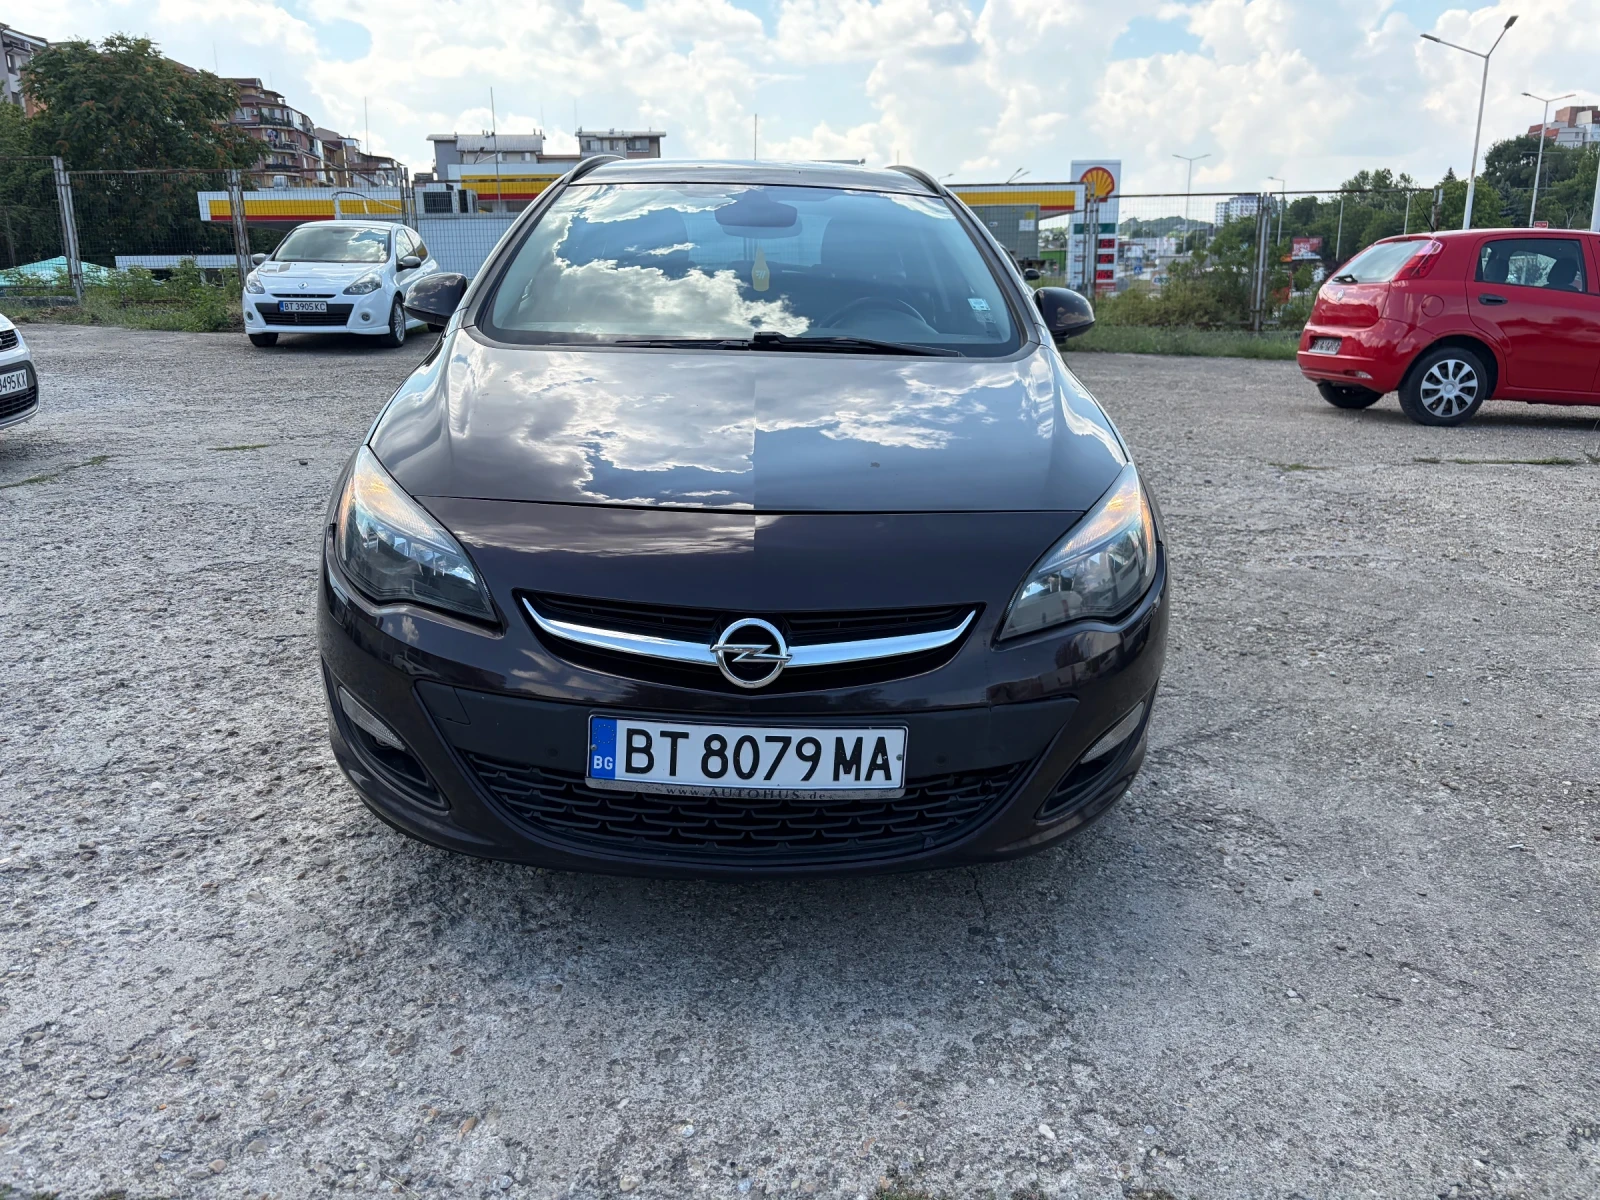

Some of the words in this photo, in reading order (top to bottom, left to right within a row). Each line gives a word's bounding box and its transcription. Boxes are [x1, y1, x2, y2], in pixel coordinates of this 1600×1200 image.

[284, 302, 294, 310] BT
[296, 302, 314, 310] 3905
[315, 302, 326, 311] KC
[625, 727, 690, 777] BT
[701, 733, 822, 782] 8079
[832, 736, 892, 782] MA
[593, 755, 614, 771] BG
